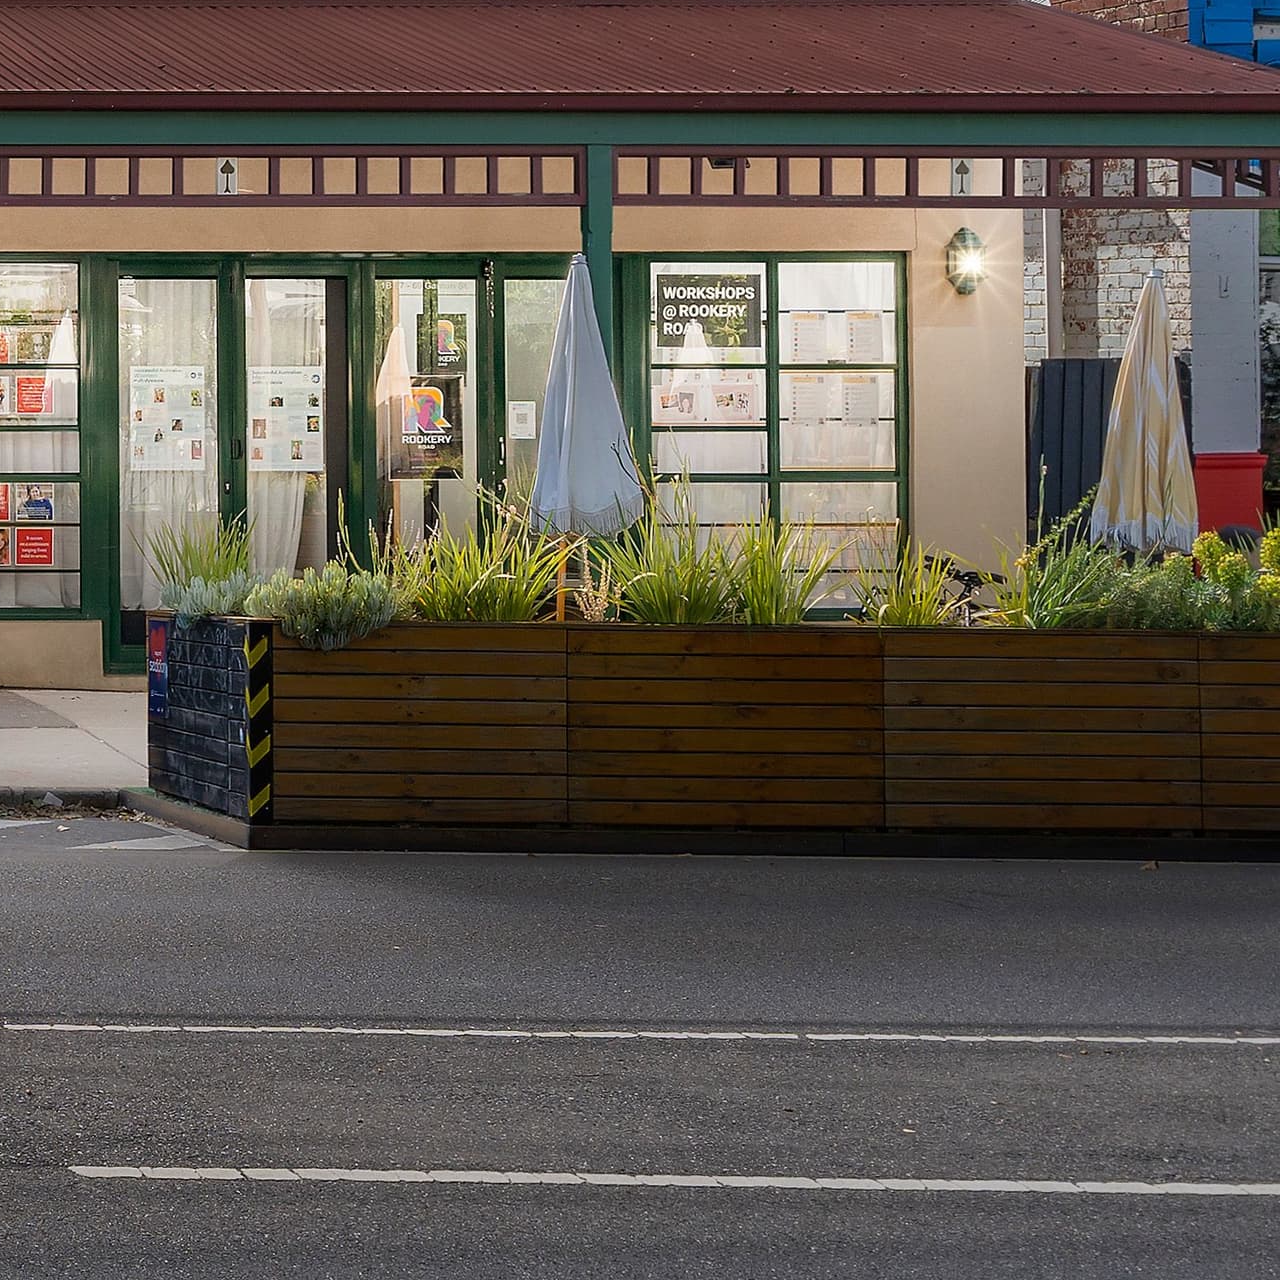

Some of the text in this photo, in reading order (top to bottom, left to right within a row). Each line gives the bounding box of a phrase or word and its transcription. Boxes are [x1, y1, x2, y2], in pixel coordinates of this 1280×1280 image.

[663, 287, 755, 299] WORKSHOPS
[663, 305, 746, 319] @ ROOKERY
[402, 435, 453, 444] ROOKERY
